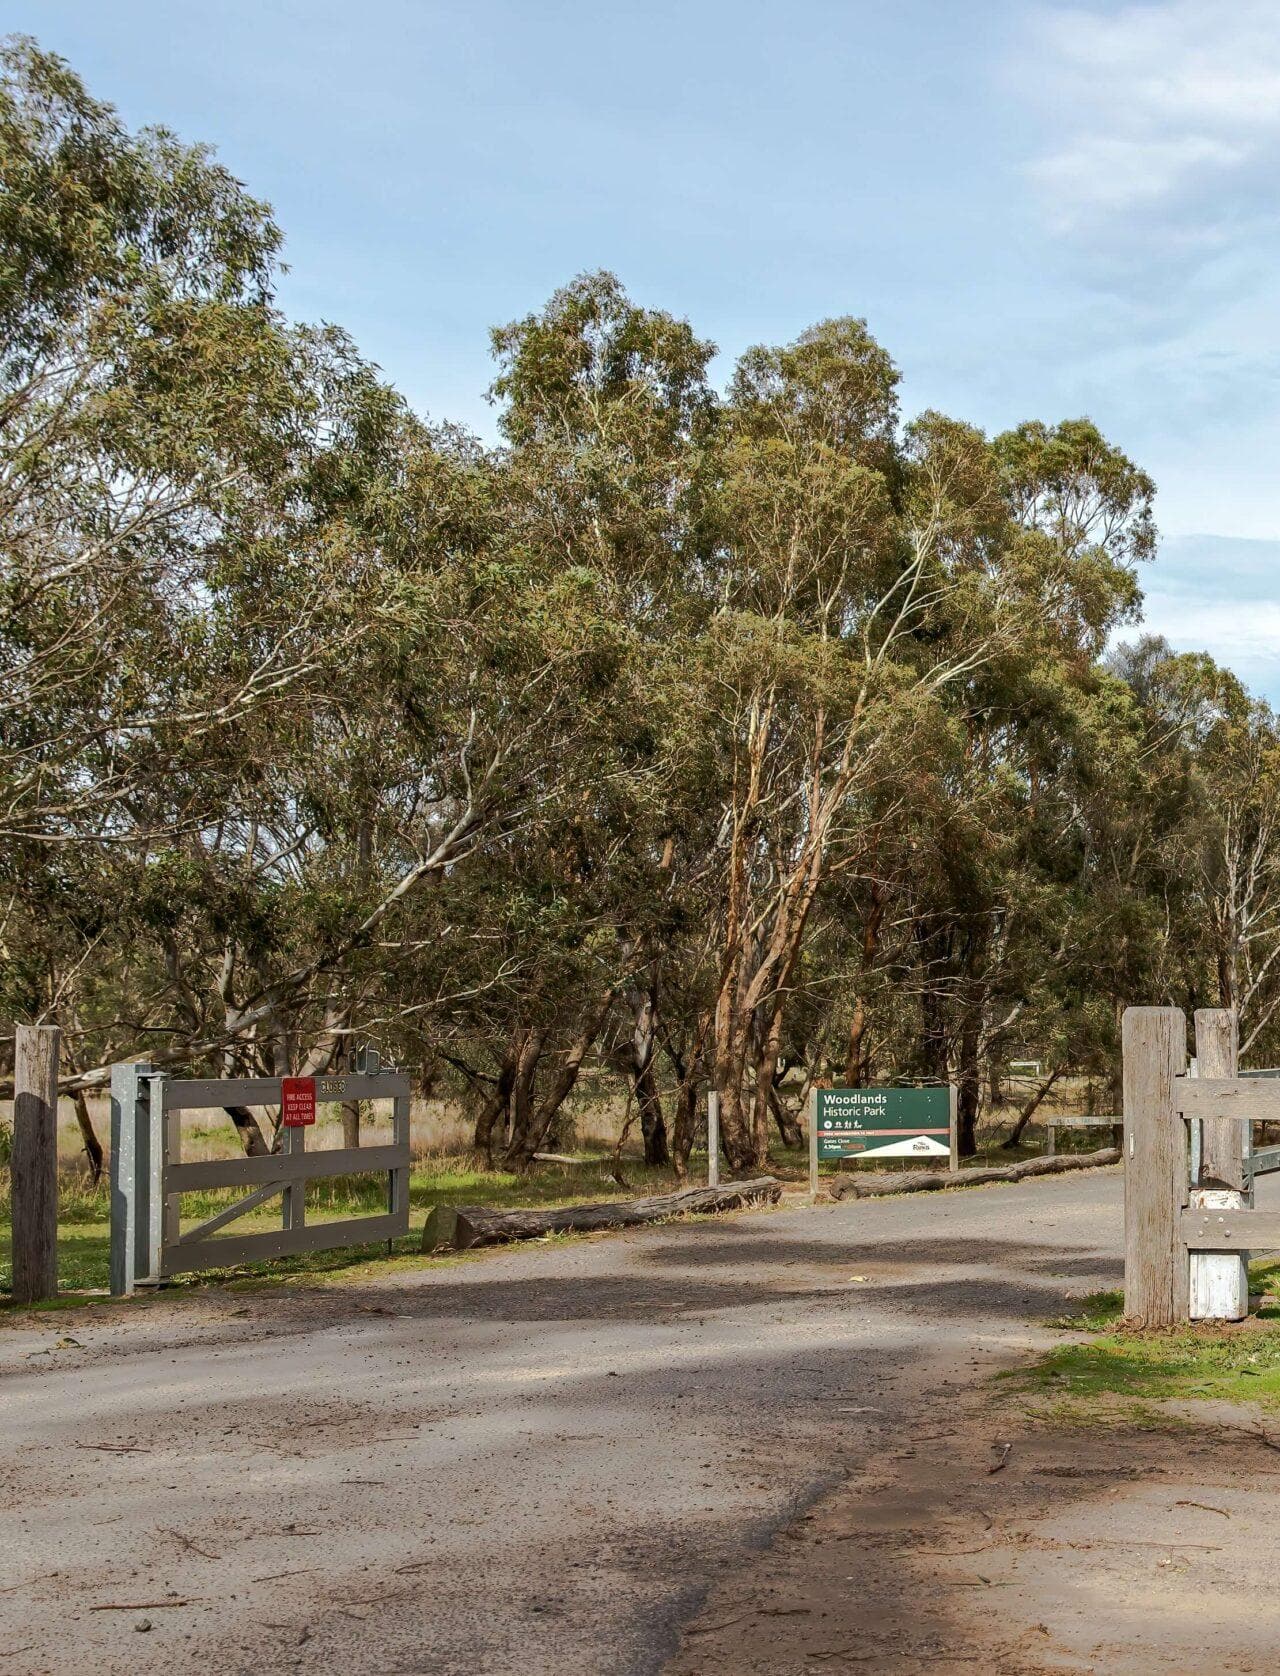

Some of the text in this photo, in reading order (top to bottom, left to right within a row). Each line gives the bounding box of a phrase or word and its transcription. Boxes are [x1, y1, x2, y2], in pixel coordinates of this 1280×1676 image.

[823, 1094, 887, 1105] Woodlands
[823, 1106, 886, 1117] Historic Park
